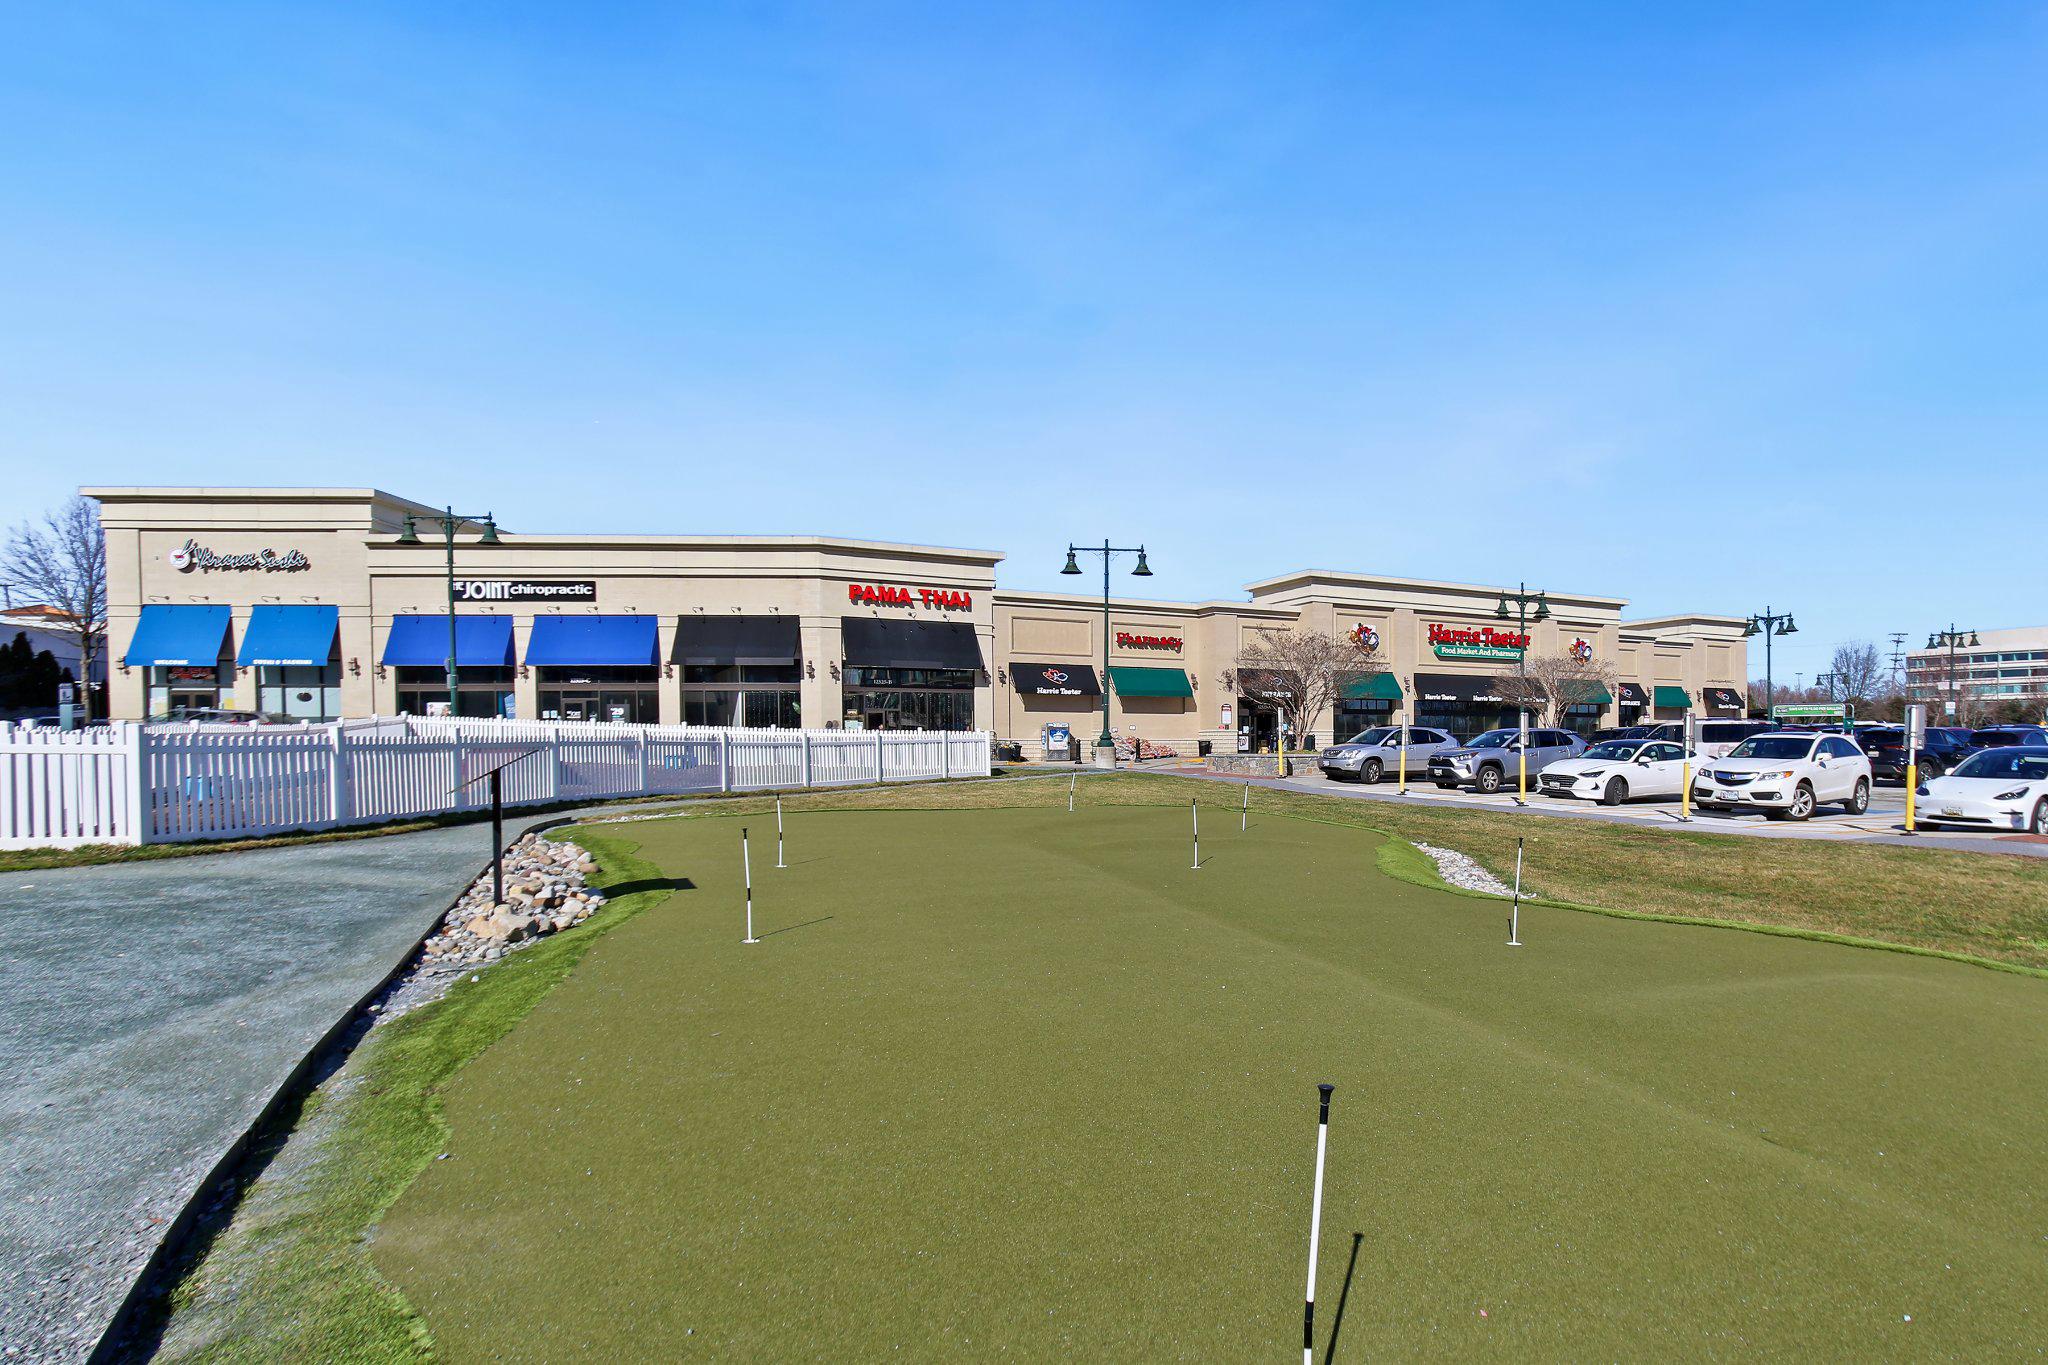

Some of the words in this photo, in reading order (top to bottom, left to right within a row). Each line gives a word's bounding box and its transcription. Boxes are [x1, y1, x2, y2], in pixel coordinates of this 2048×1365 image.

[259, 547, 307, 569] Sushi
[462, 581, 512, 599] JOINT
[510, 584, 593, 596] chiropractic
[849, 584, 914, 604] PAMA
[918, 588, 972, 608] THAI
[1427, 623, 1481, 644] Harris
[1441, 646, 1456, 654] Food
[1457, 648, 1478, 656] Market
[1491, 650, 1521, 658] Pharmacy
[1036, 686, 1060, 694] Harris
[1060, 687, 1082, 695] Teeter
